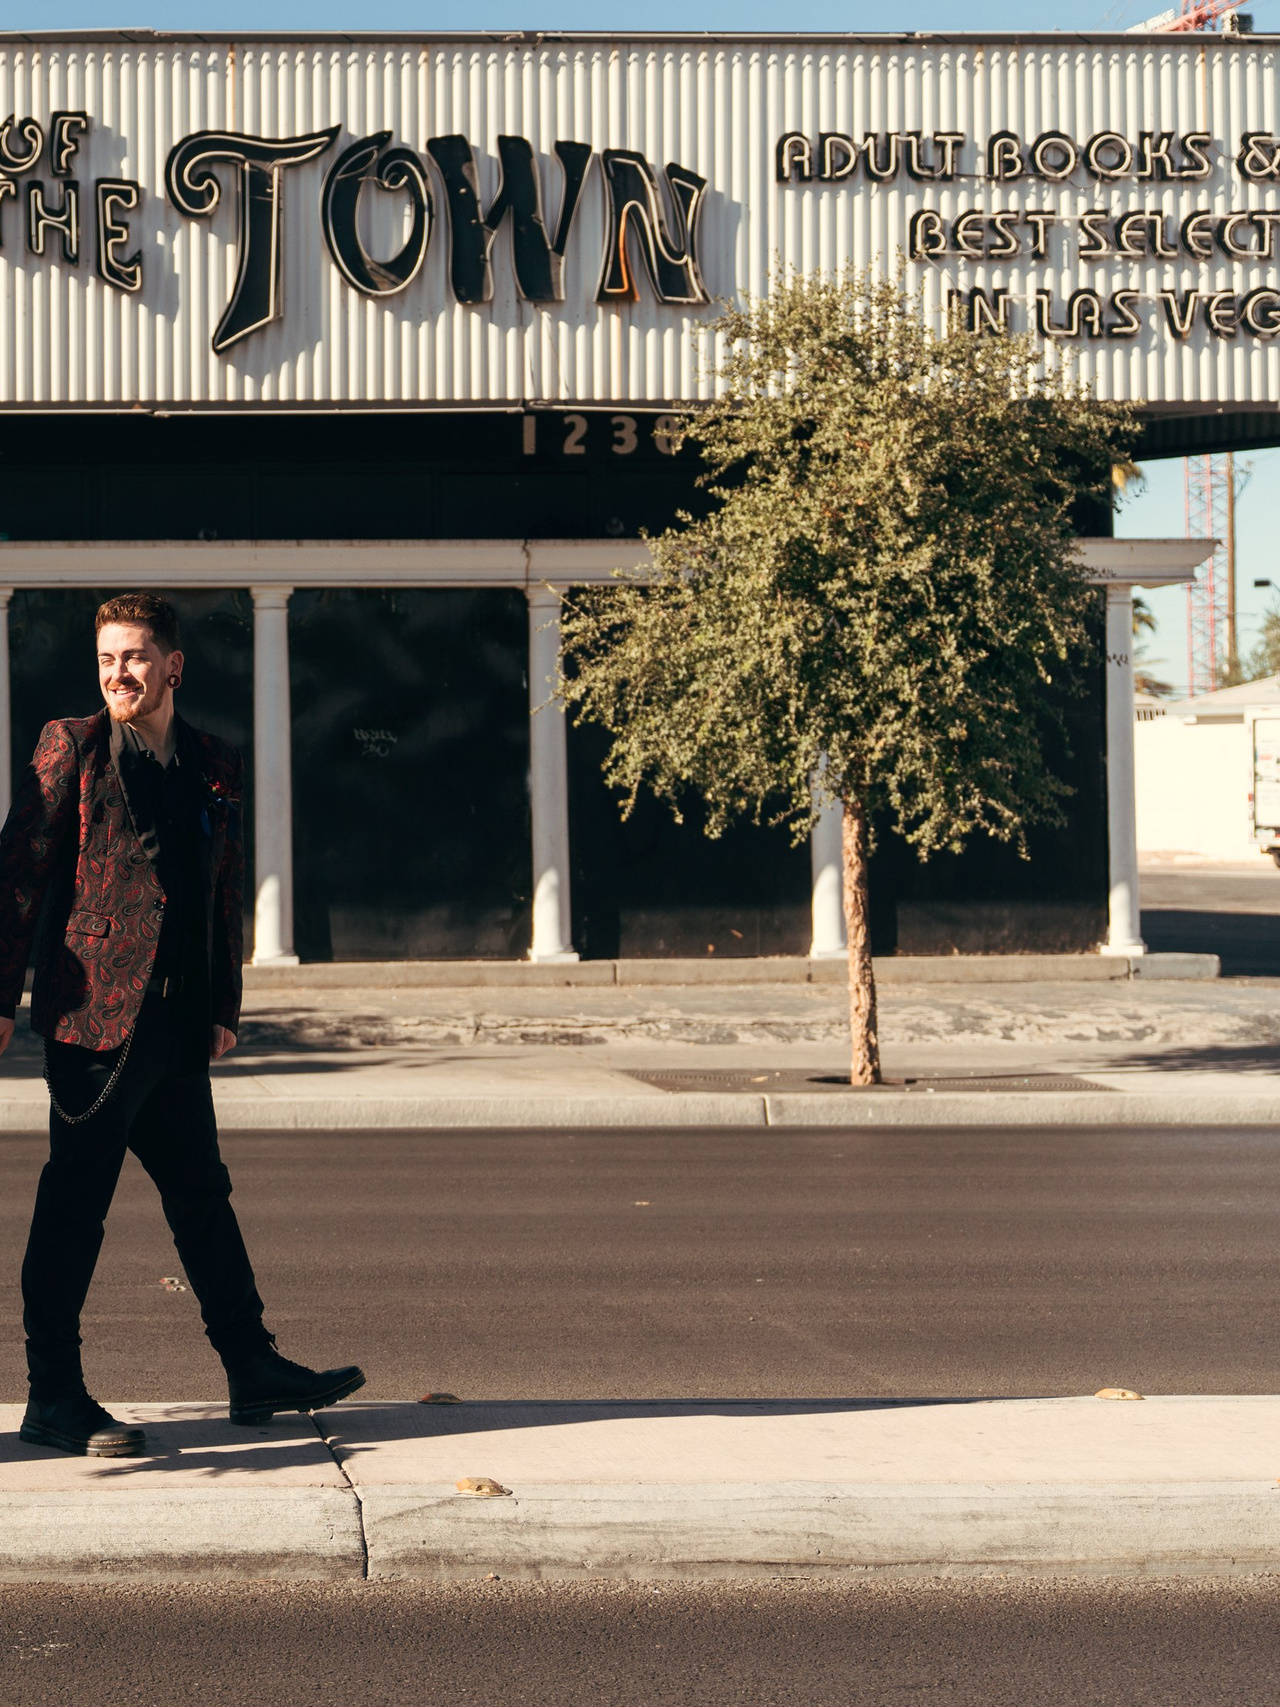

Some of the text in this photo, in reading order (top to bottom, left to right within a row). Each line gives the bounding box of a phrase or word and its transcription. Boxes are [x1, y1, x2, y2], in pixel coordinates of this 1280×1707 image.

[775, 130, 964, 182] ADULT
[986, 129, 1211, 182] BOOKS
[165, 123, 713, 355] TOWN
[908, 208, 1280, 261] BEST SELECT
[947, 286, 1280, 339] IN LAS VEG
